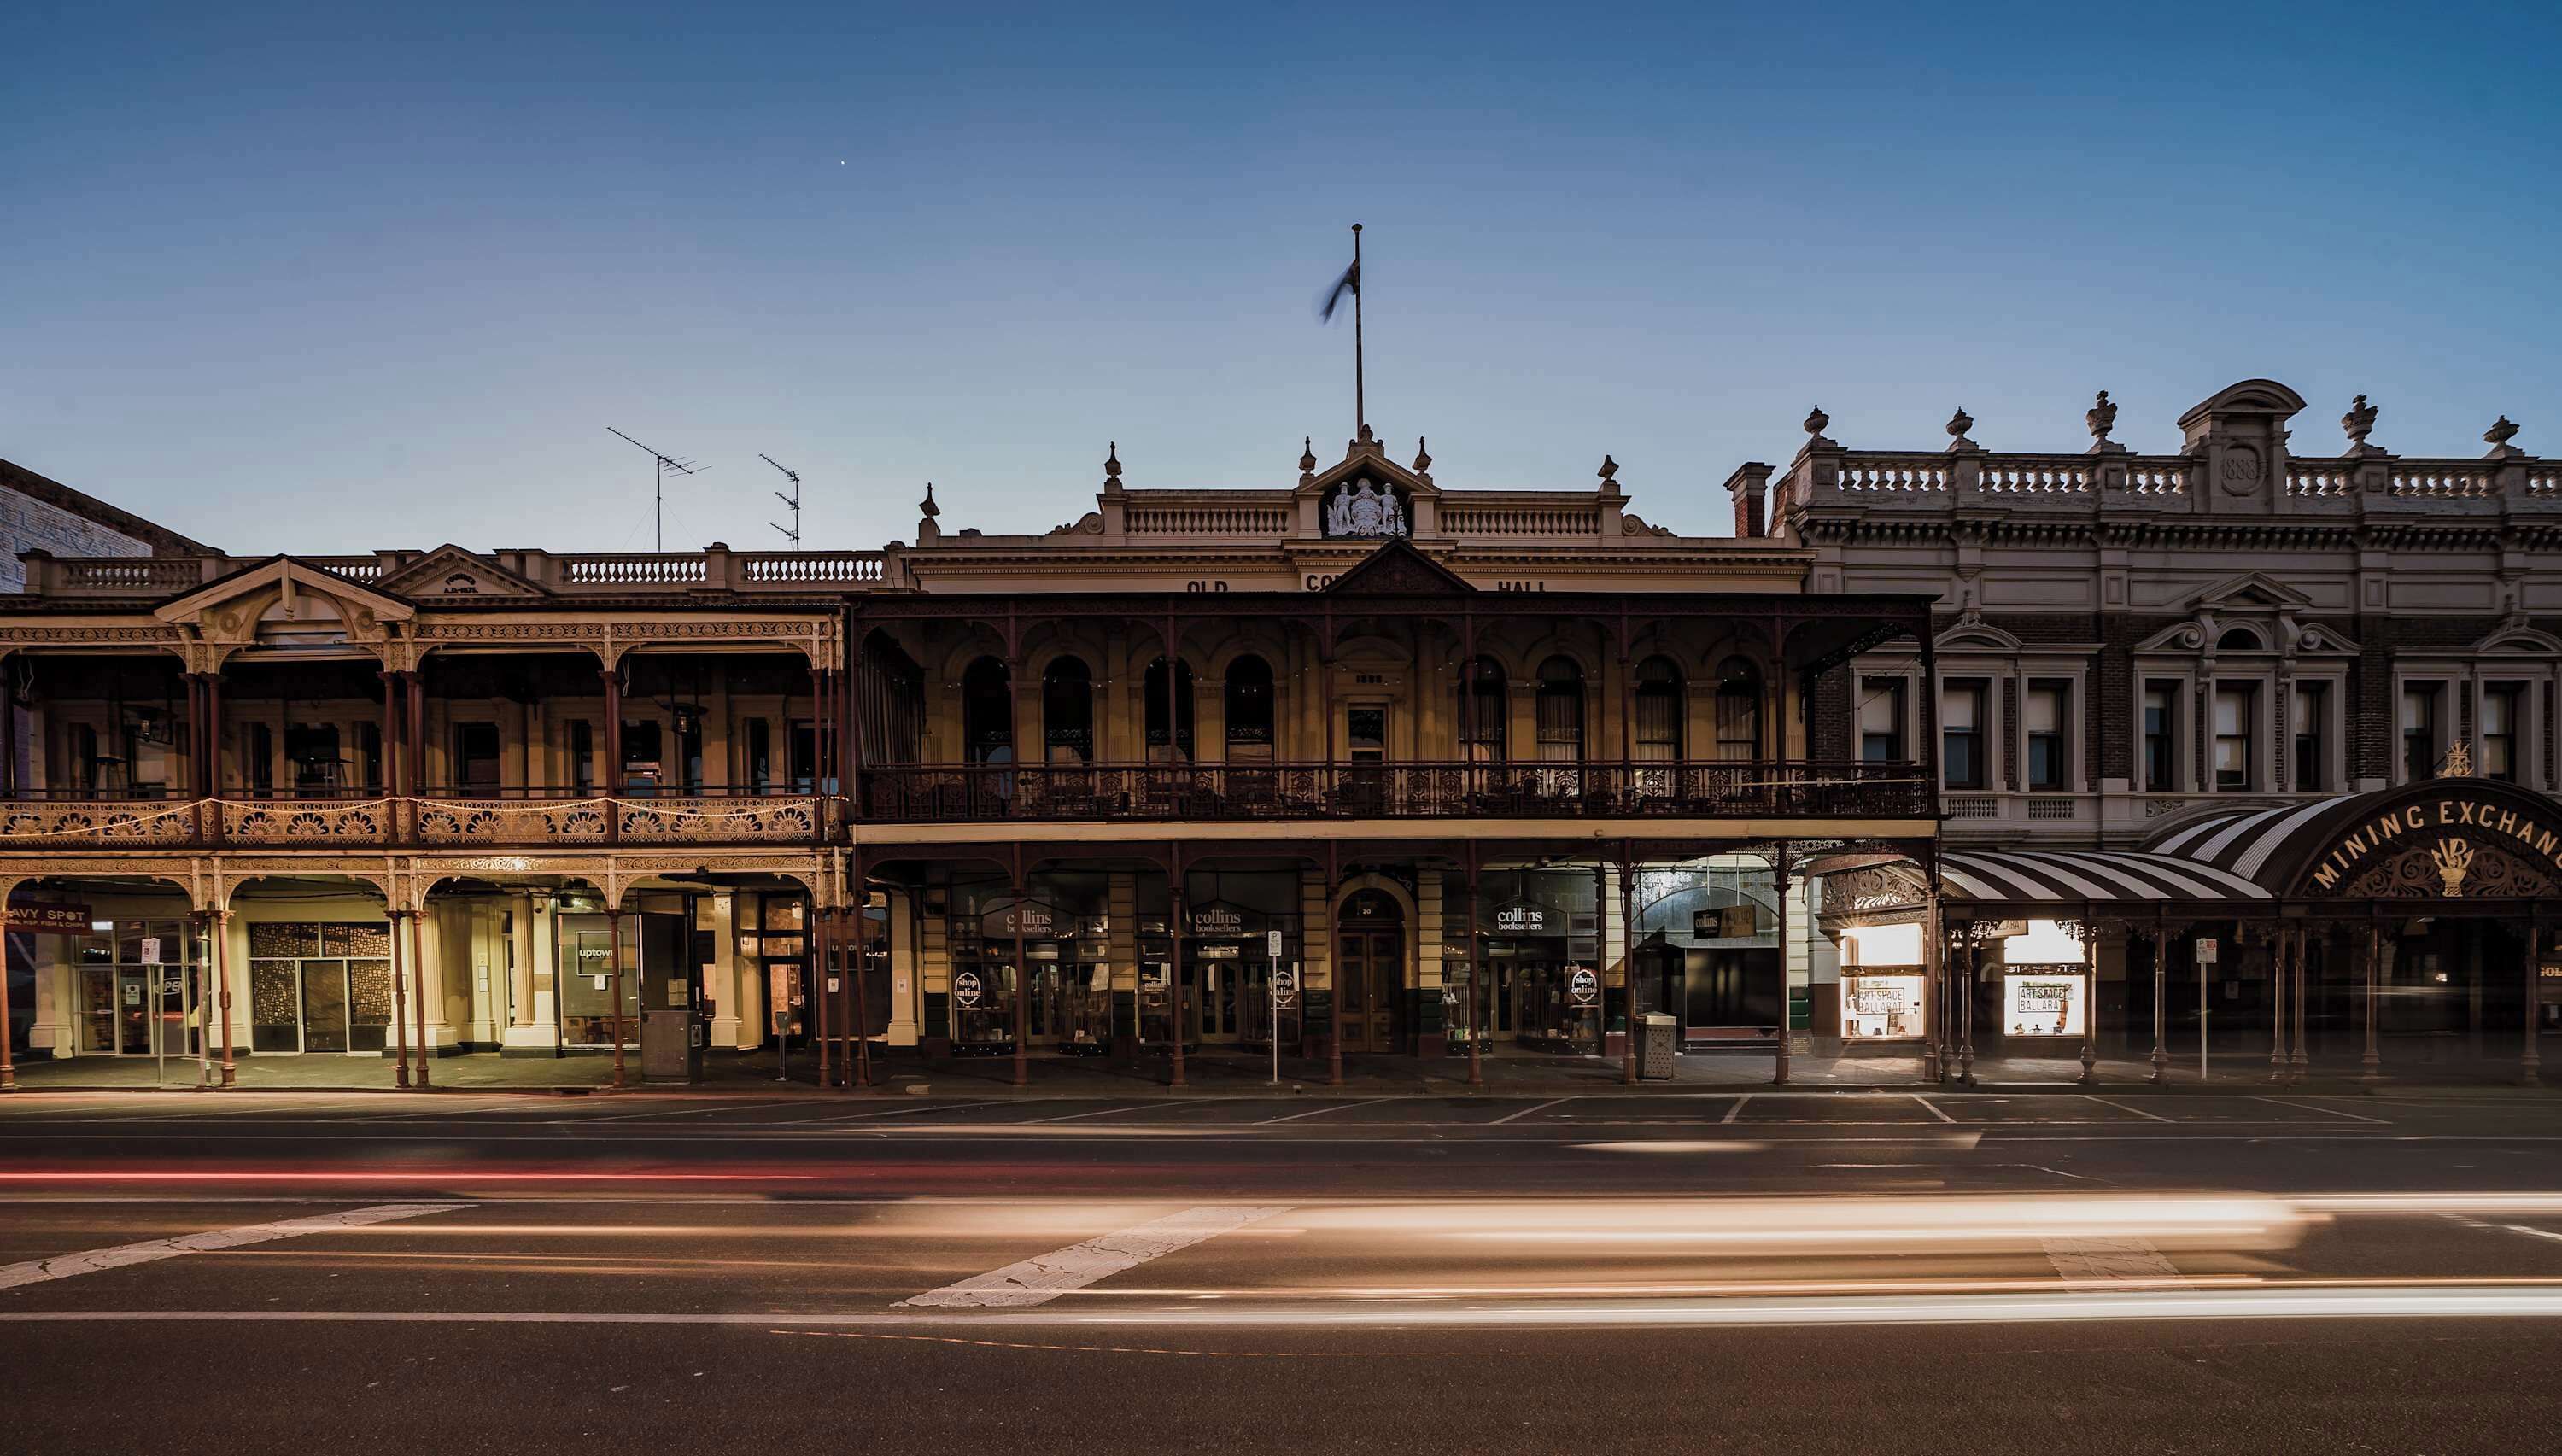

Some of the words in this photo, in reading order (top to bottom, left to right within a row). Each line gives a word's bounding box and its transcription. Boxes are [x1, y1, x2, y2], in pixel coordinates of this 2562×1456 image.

[2313, 804, 2425, 890] MINING
[8, 908, 39, 919] AVY
[47, 909, 85, 921] SPOT
[1006, 910, 1052, 924] cllins
[1196, 909, 1241, 923] collins
[1497, 907, 1543, 921] collins
[1695, 913, 1717, 928] collins
[1196, 923, 1241, 932] booksellers
[958, 978, 977, 988] shop
[1276, 977, 1293, 987] hop
[1576, 975, 1594, 985] shop
[955, 988, 981, 997] online
[1571, 985, 1597, 994] online
[2021, 989, 2036, 999] ART
[2038, 989, 2063, 999] SPACE
[1859, 990, 1875, 1001] ART
[1876, 990, 1902, 1001] SPACE
[1858, 1002, 1902, 1012] BALLARAT
[2020, 1000, 2063, 1010] BALLARAT
